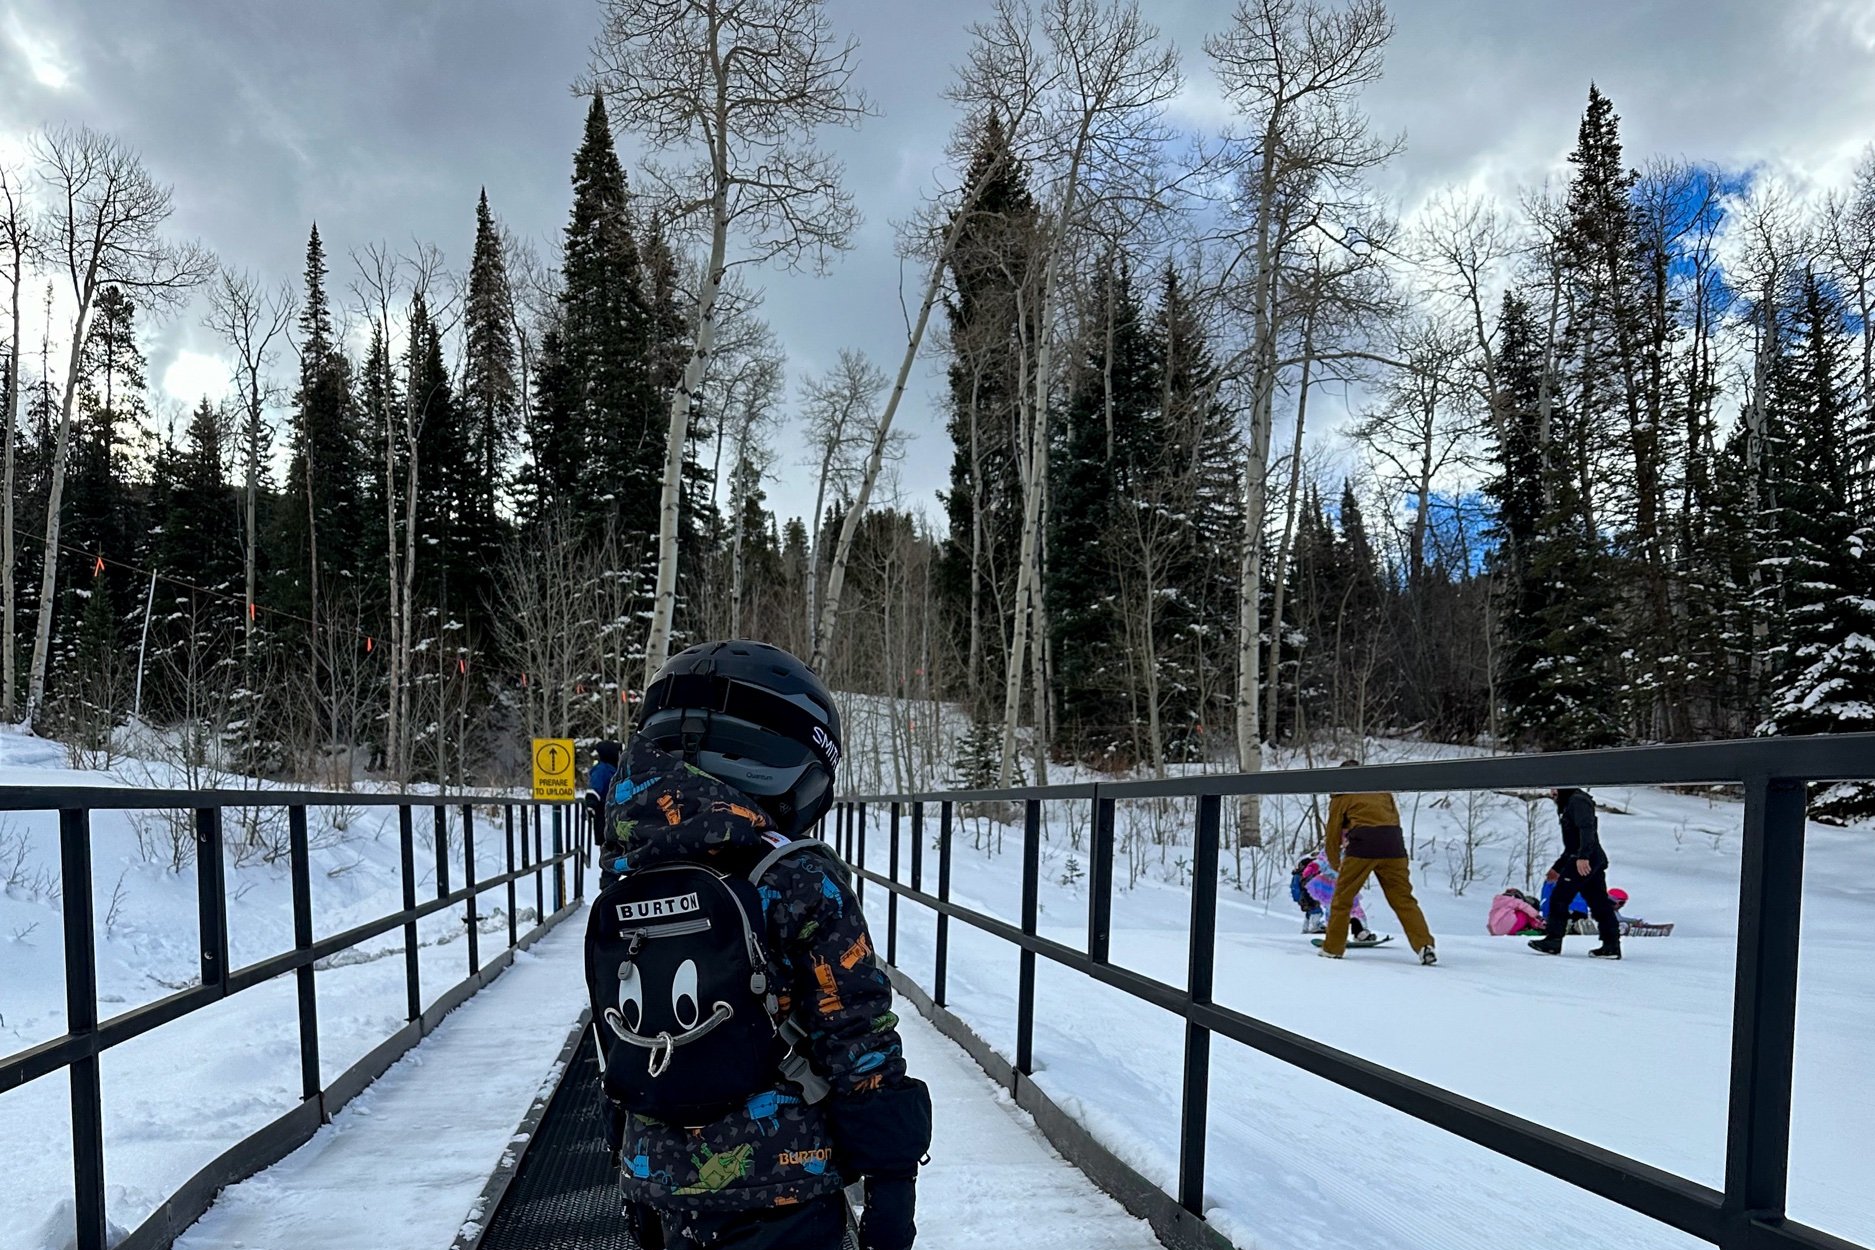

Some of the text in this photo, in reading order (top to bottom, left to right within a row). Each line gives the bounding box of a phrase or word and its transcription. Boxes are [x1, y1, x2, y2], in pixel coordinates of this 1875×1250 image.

[812, 726, 840, 770] SMITH
[539, 778, 568, 787] PREPARE
[536, 788, 573, 796] TO UNLOAD
[620, 895, 697, 918] BURTON
[778, 1148, 832, 1165] BURTON
